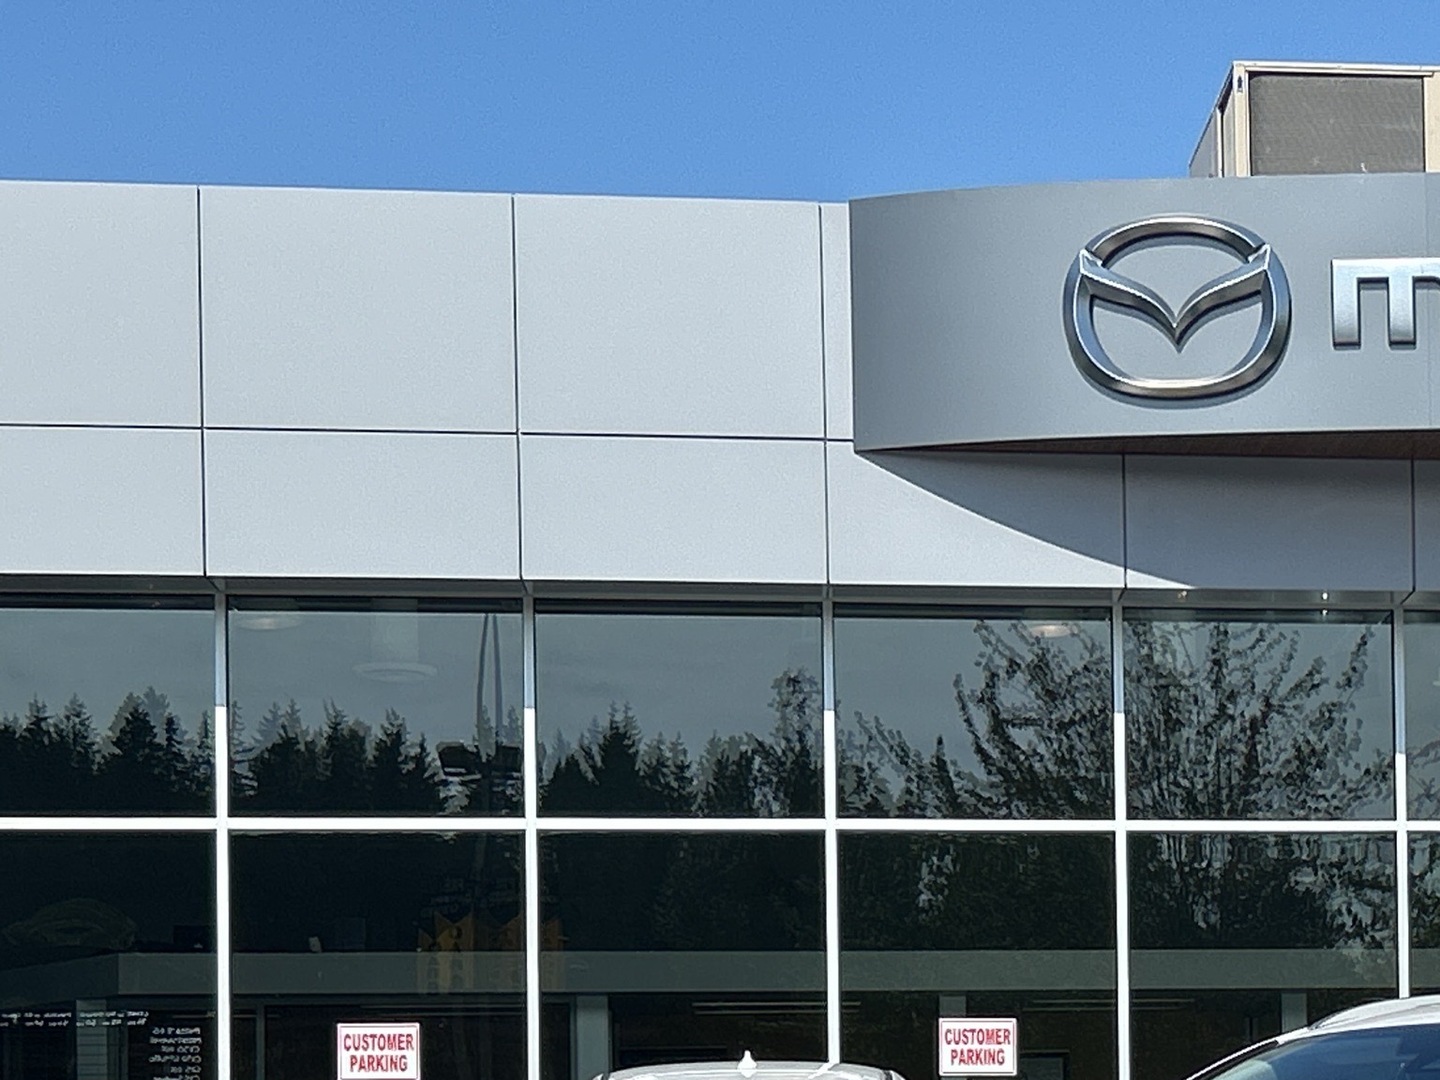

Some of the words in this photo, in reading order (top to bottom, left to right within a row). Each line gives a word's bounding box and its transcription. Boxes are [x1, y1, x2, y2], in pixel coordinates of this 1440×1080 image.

[343, 1033, 415, 1052] CUSTOMER
[944, 1028, 1011, 1046] CUSTOMER
[350, 1054, 408, 1073] PARKING
[951, 1048, 1006, 1066] PARKING
